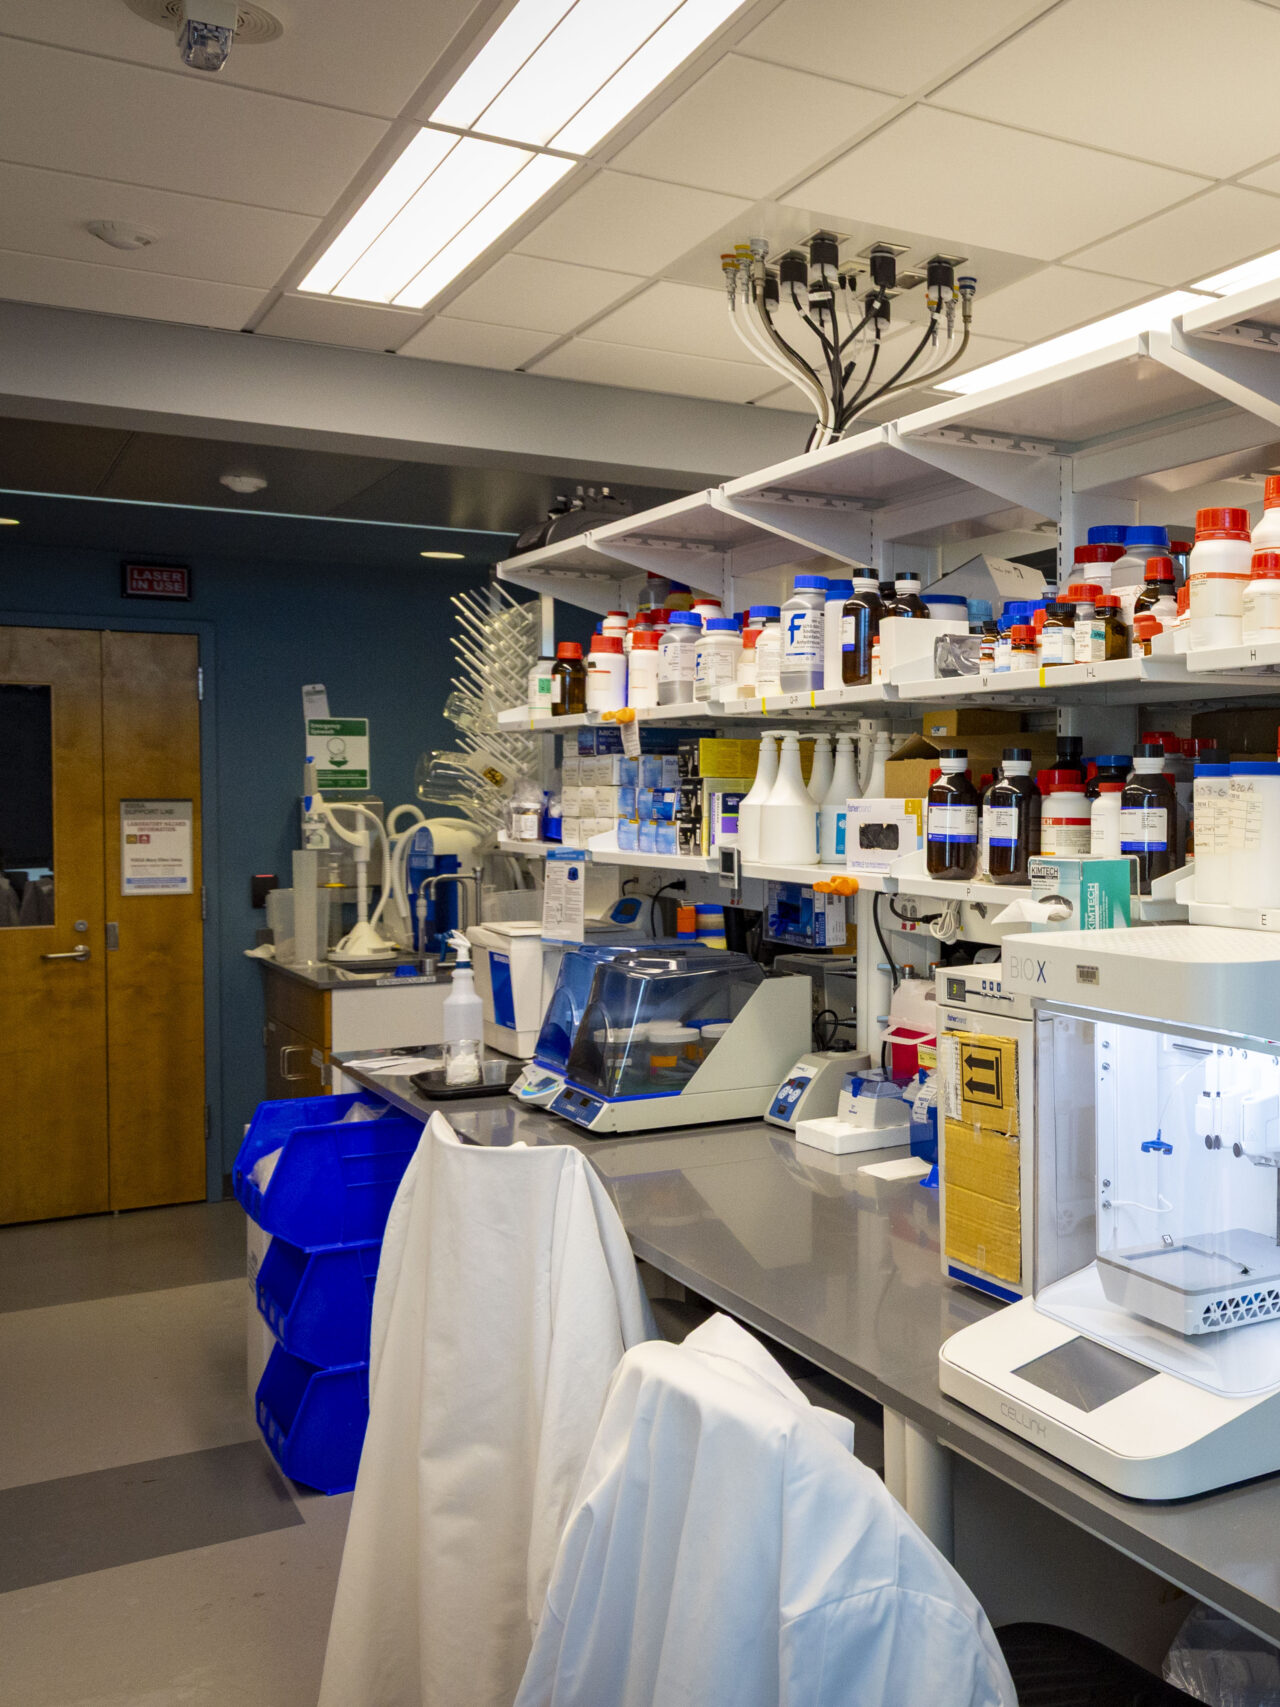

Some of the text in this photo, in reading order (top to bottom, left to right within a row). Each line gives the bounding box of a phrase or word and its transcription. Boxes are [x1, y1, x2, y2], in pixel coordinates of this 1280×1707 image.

[133, 570, 182, 582] LASER
[132, 580, 182, 592] IN USE
[1250, 650, 1256, 660] H
[983, 678, 988, 688] M
[1032, 866, 1058, 876] KIMTECH
[1088, 882, 1097, 930] KIMTECH
[1262, 914, 1266, 926] E
[1010, 956, 1034, 981] BIO
[1037, 960, 1047, 984] X
